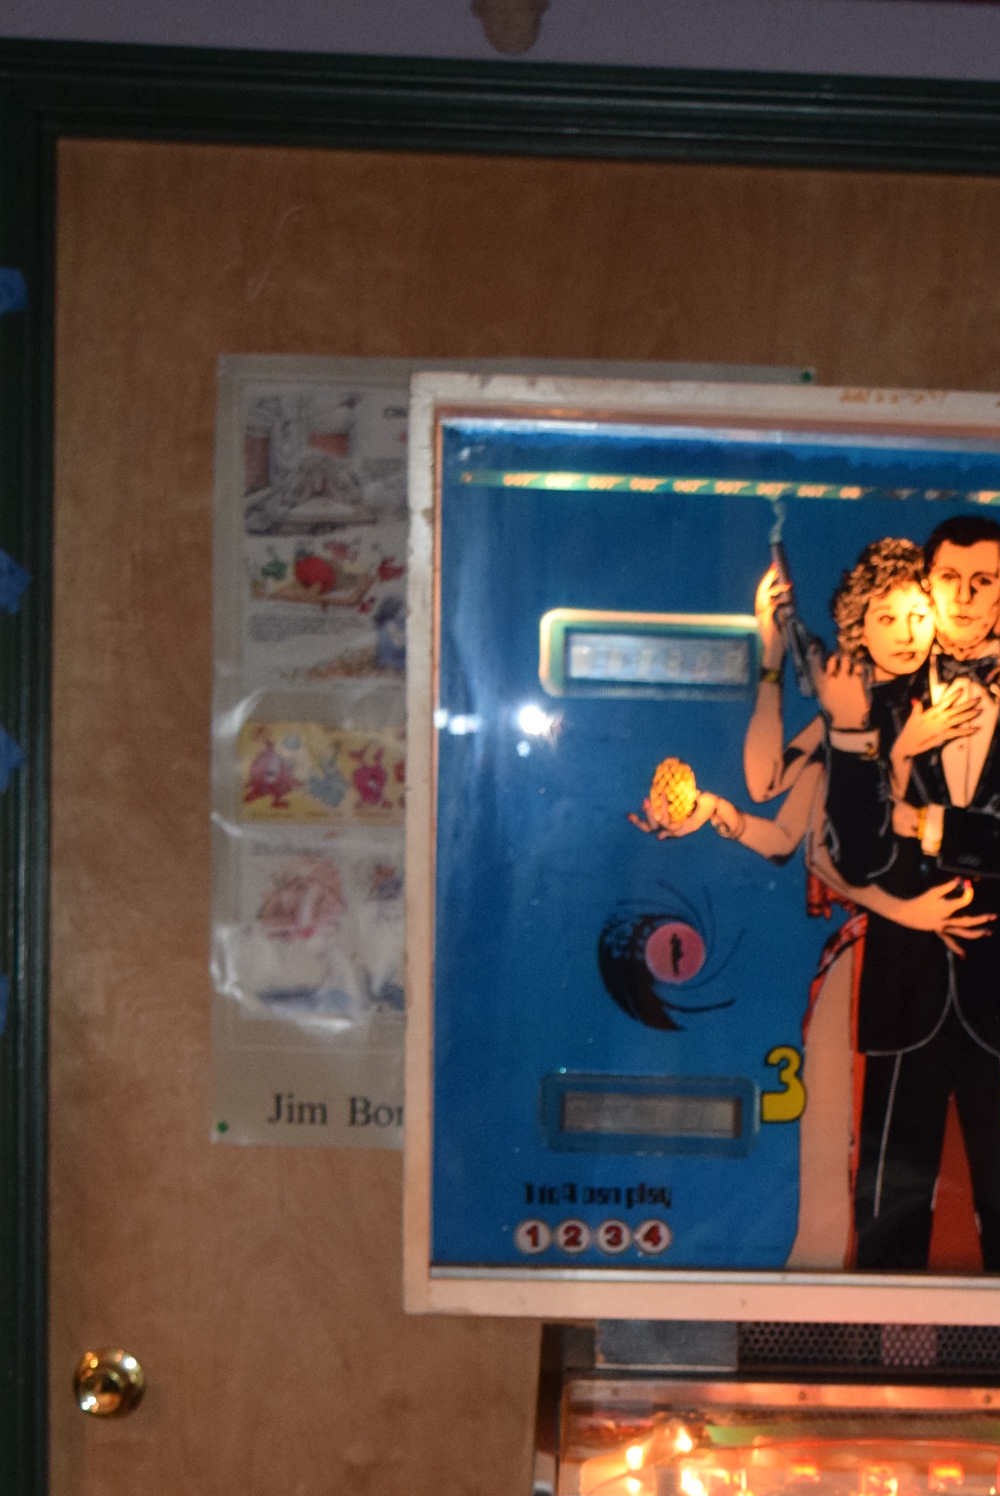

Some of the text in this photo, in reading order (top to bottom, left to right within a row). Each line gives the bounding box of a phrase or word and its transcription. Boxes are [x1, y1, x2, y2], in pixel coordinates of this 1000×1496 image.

[761, 1045, 806, 1123] 3
[268, 1092, 328, 1126] Jim
[526, 1224, 662, 1247] 1 2 3 4
